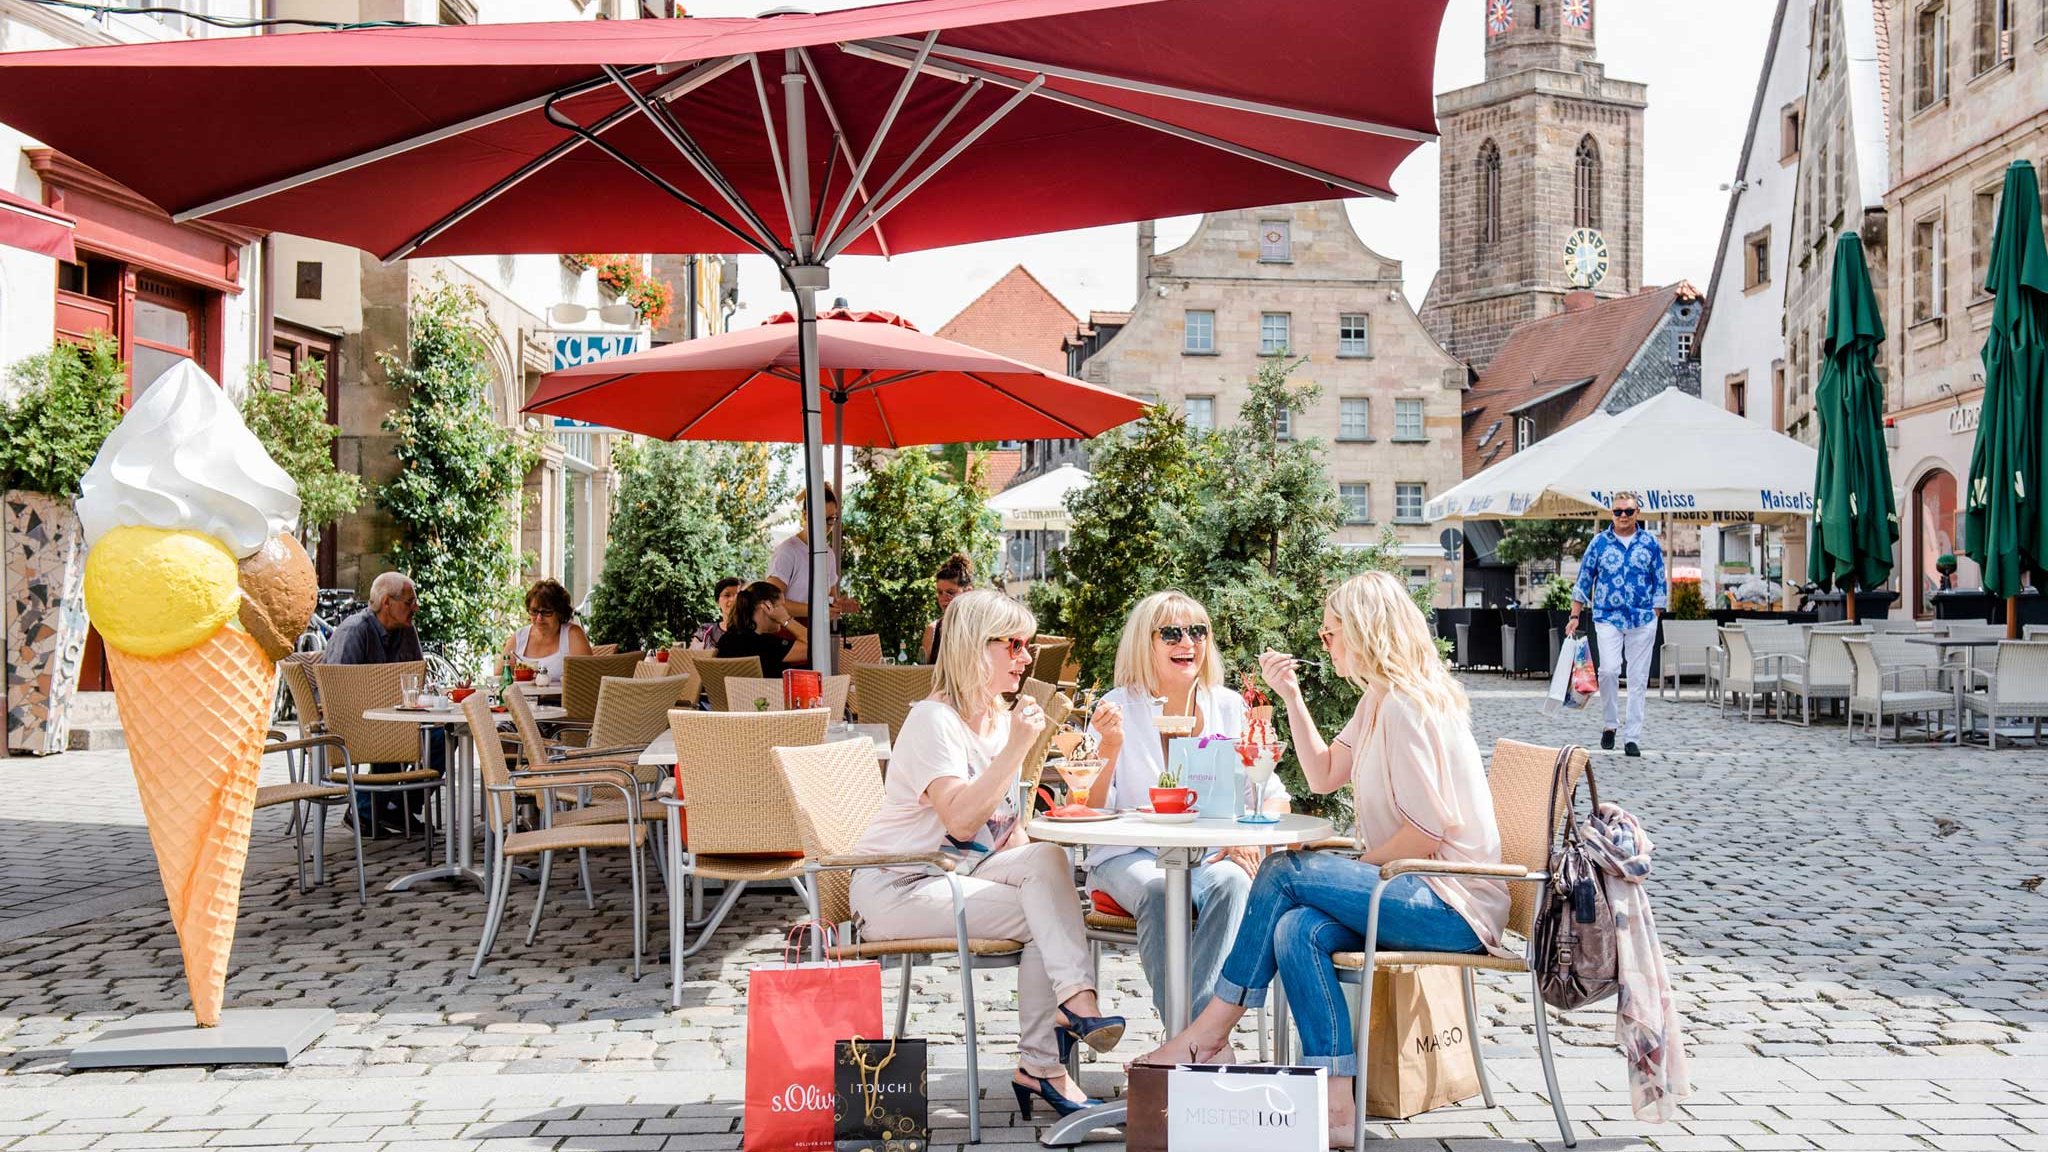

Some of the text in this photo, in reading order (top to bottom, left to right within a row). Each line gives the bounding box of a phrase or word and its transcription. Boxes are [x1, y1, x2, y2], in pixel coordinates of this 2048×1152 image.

[1647, 490, 1695, 509] Weisse
[1760, 490, 1813, 509] Maisel's
[1416, 1026, 1462, 1054] MAGO
[771, 1084, 835, 1112] s.Oliv
